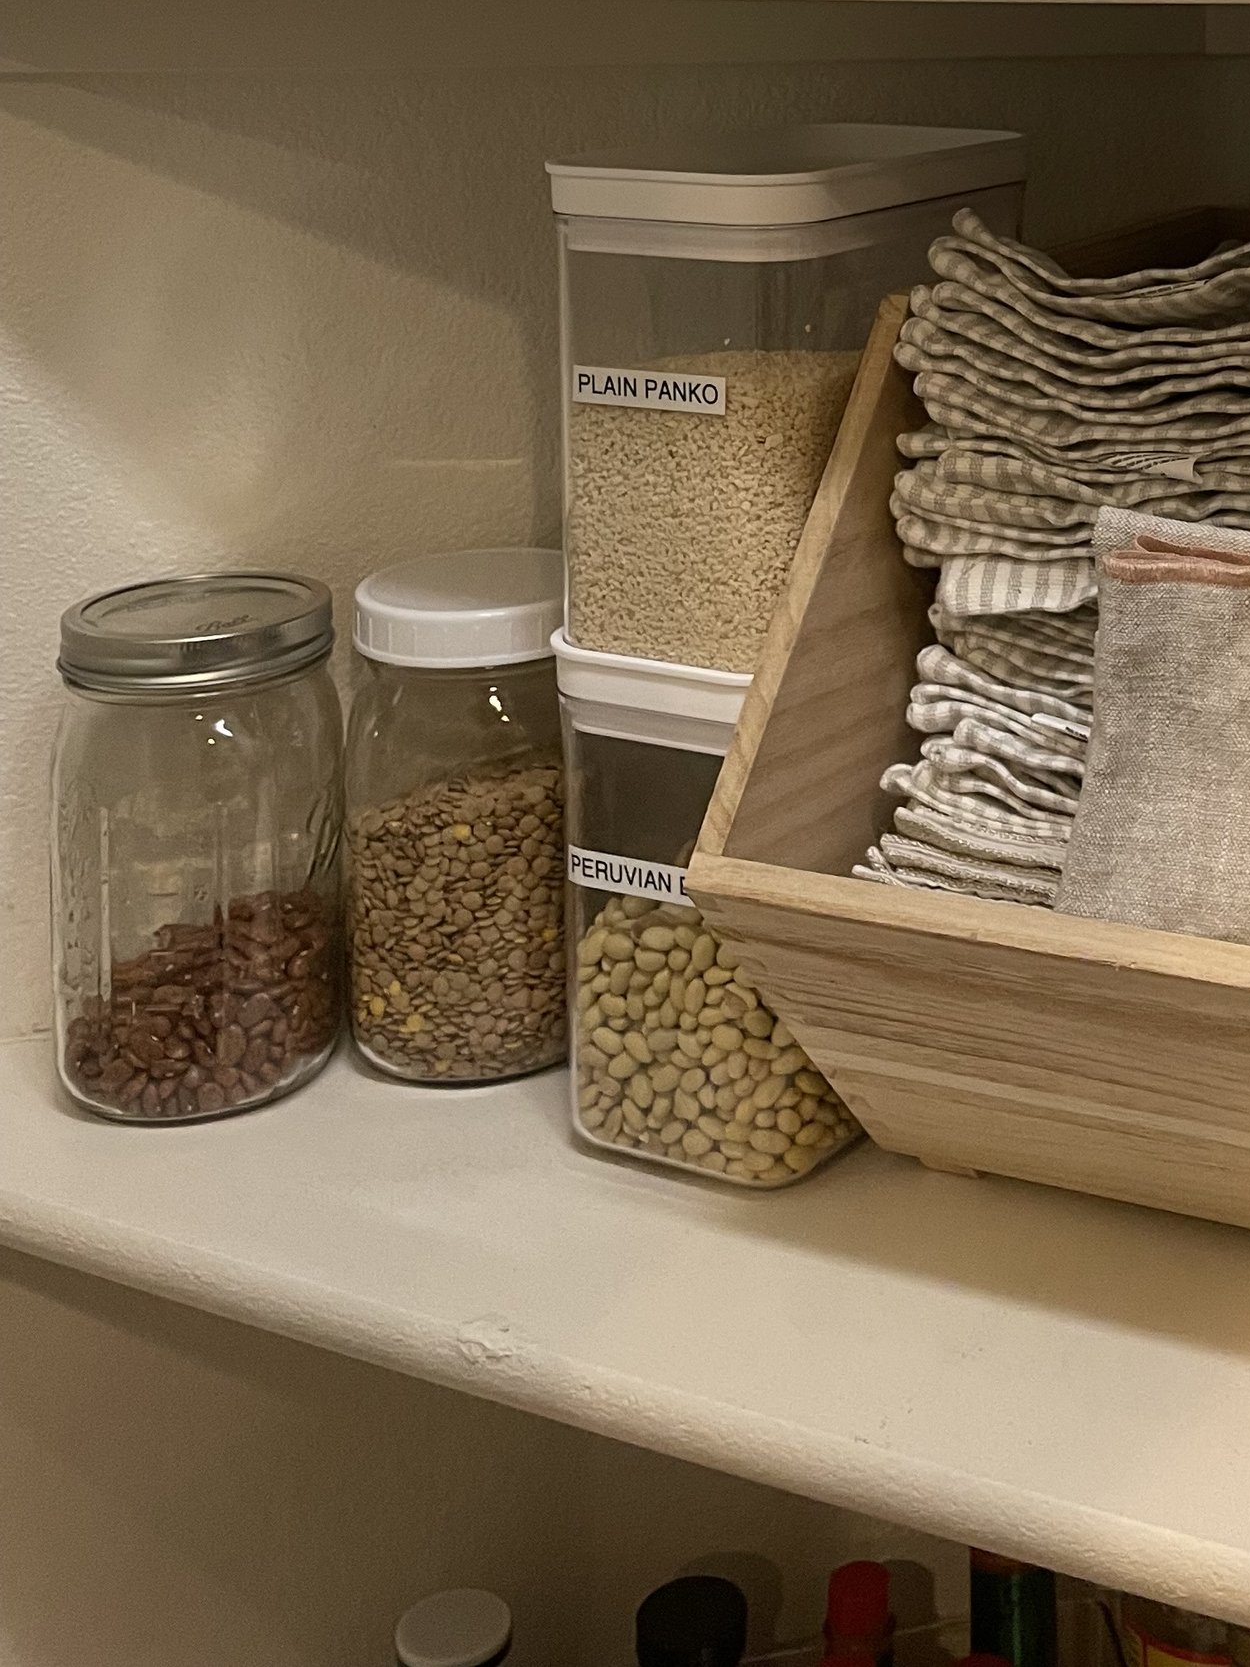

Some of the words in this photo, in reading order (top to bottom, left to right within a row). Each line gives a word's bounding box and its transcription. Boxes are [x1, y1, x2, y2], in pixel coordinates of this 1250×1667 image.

[578, 373, 637, 397] PLAIN
[645, 379, 719, 405] PANKO
[571, 854, 672, 893] PERUVIAN
